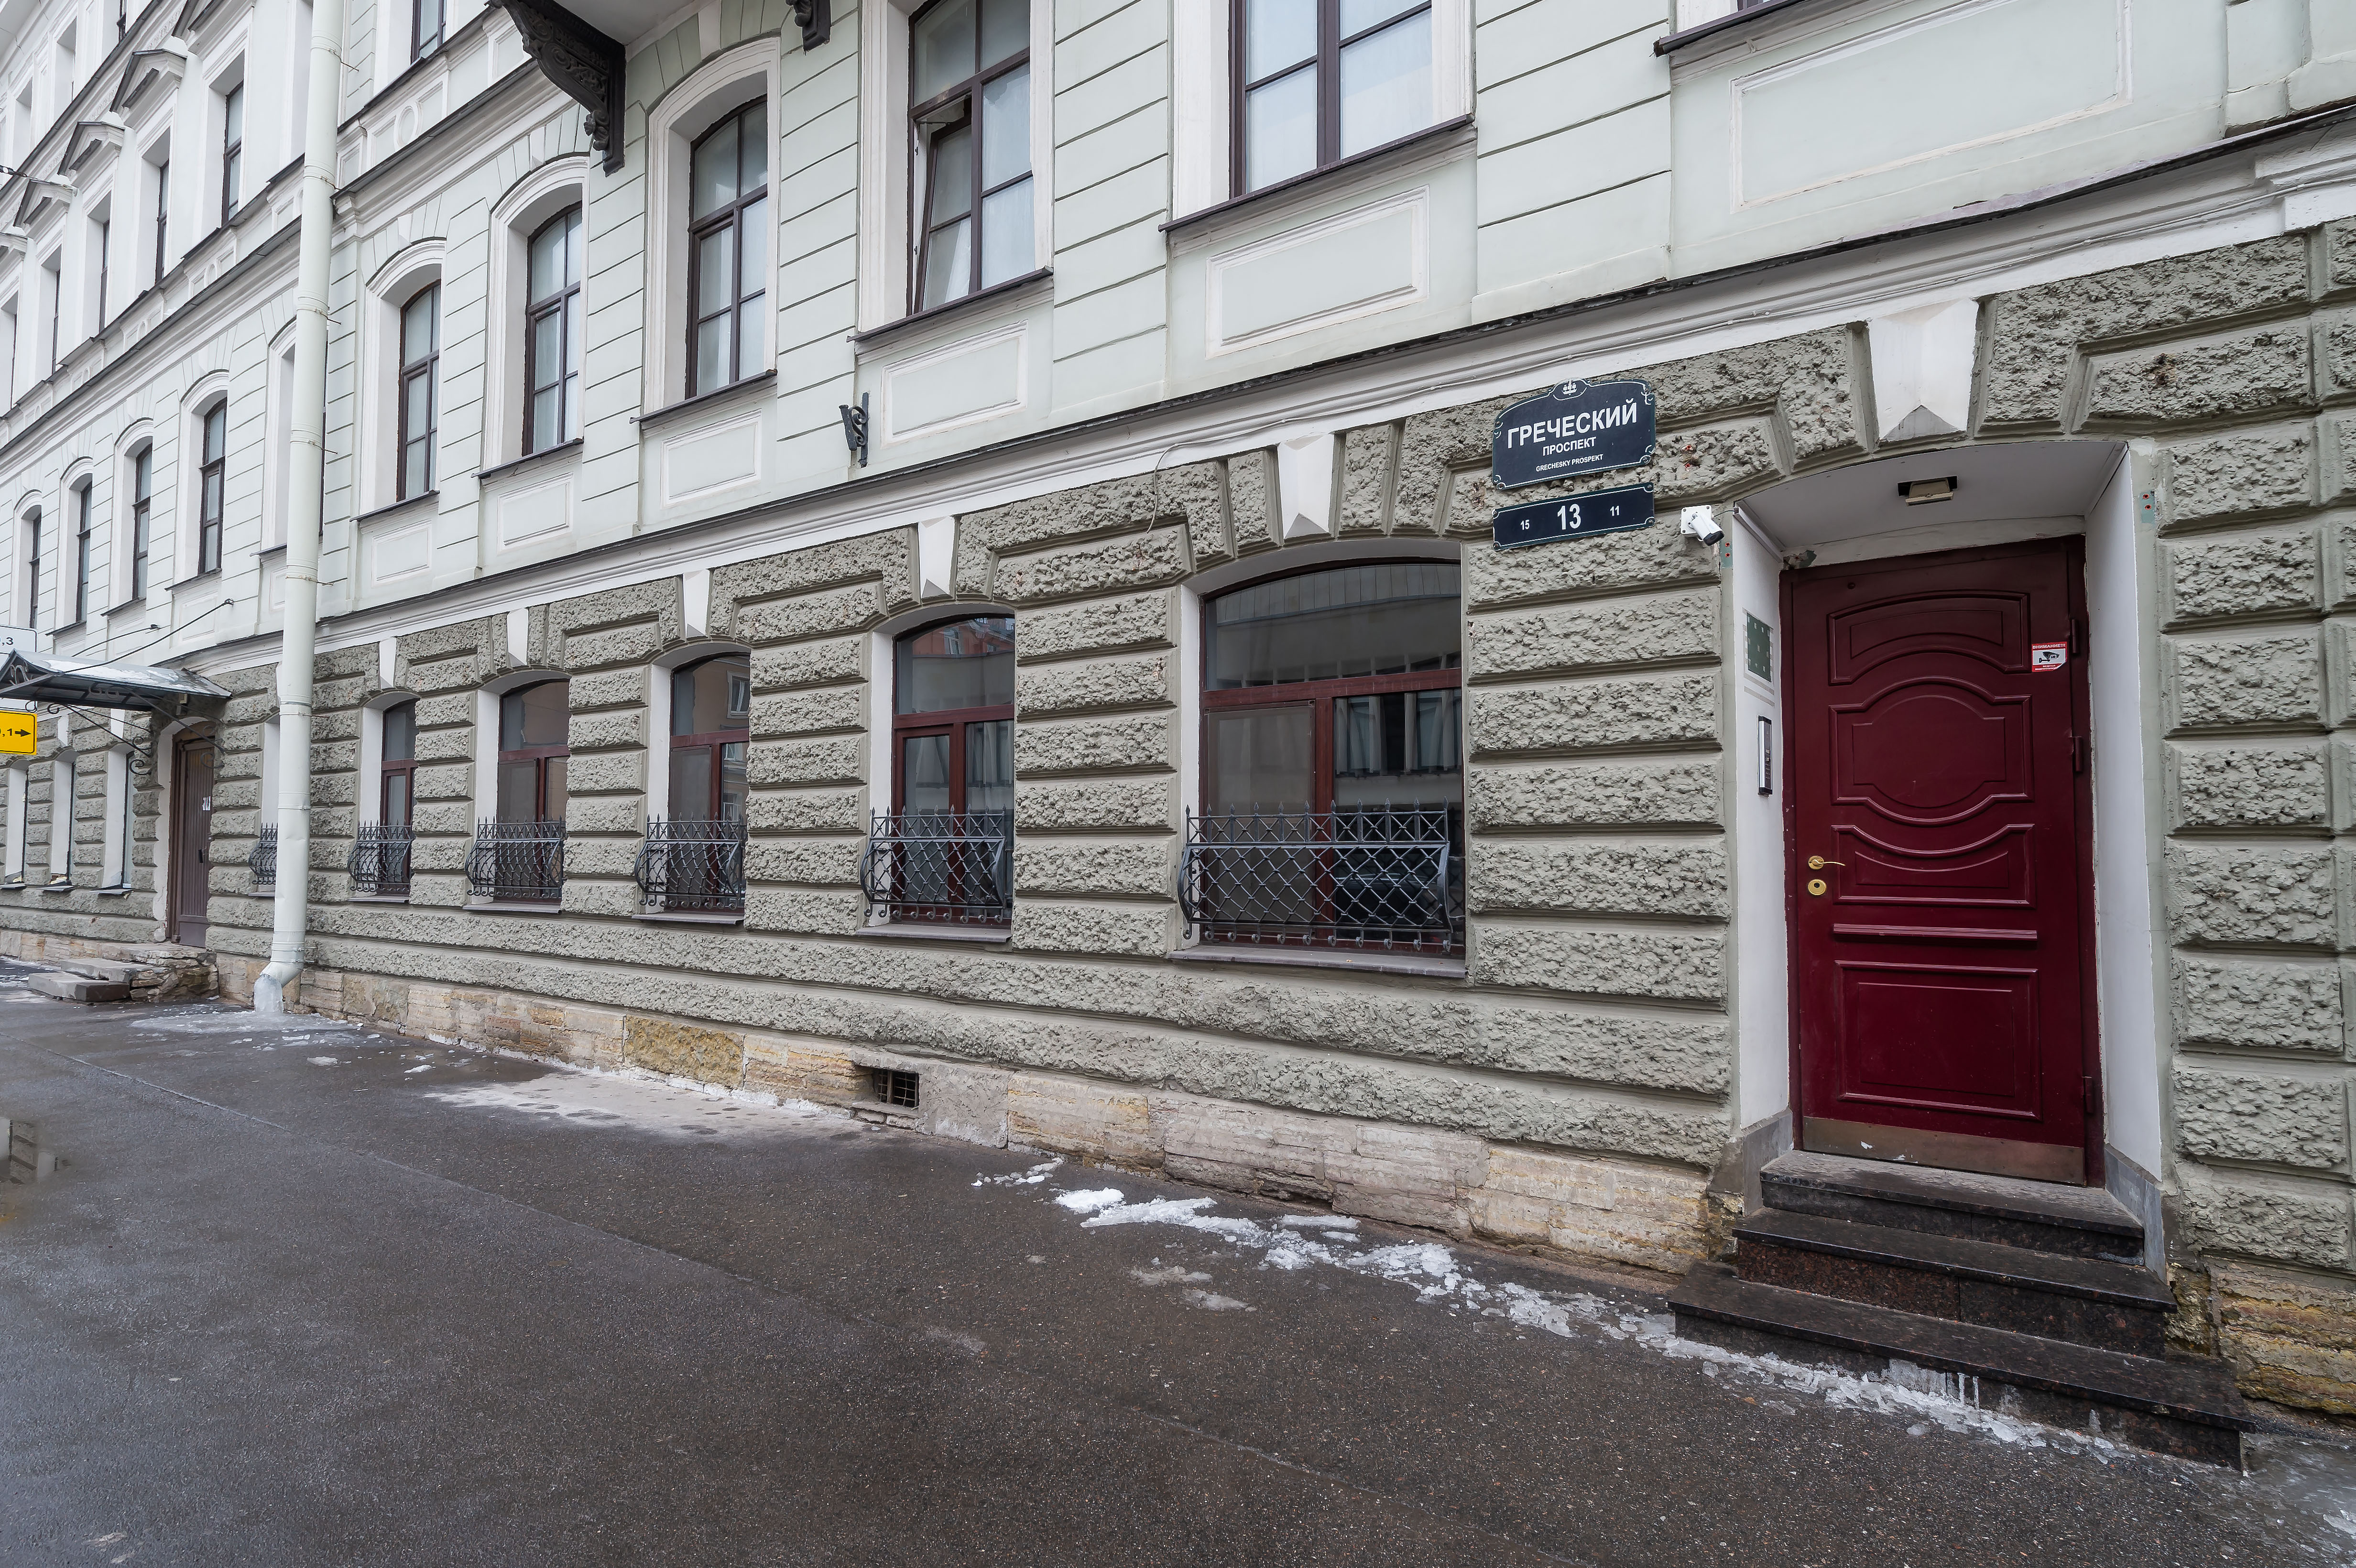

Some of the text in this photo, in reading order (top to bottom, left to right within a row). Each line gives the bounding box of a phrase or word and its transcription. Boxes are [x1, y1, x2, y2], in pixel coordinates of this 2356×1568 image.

[1507, 398, 1637, 448] ГРЕЧЕСКИЙ
[1542, 436, 1596, 456] ПРОСПЕКТ
[1536, 454, 1603, 472] GRECHESKY PROSPEKT
[1520, 503, 1620, 530] 15 13 11
[0, 637, 14, 646] ,3
[0, 728, 12, 737] ,1
